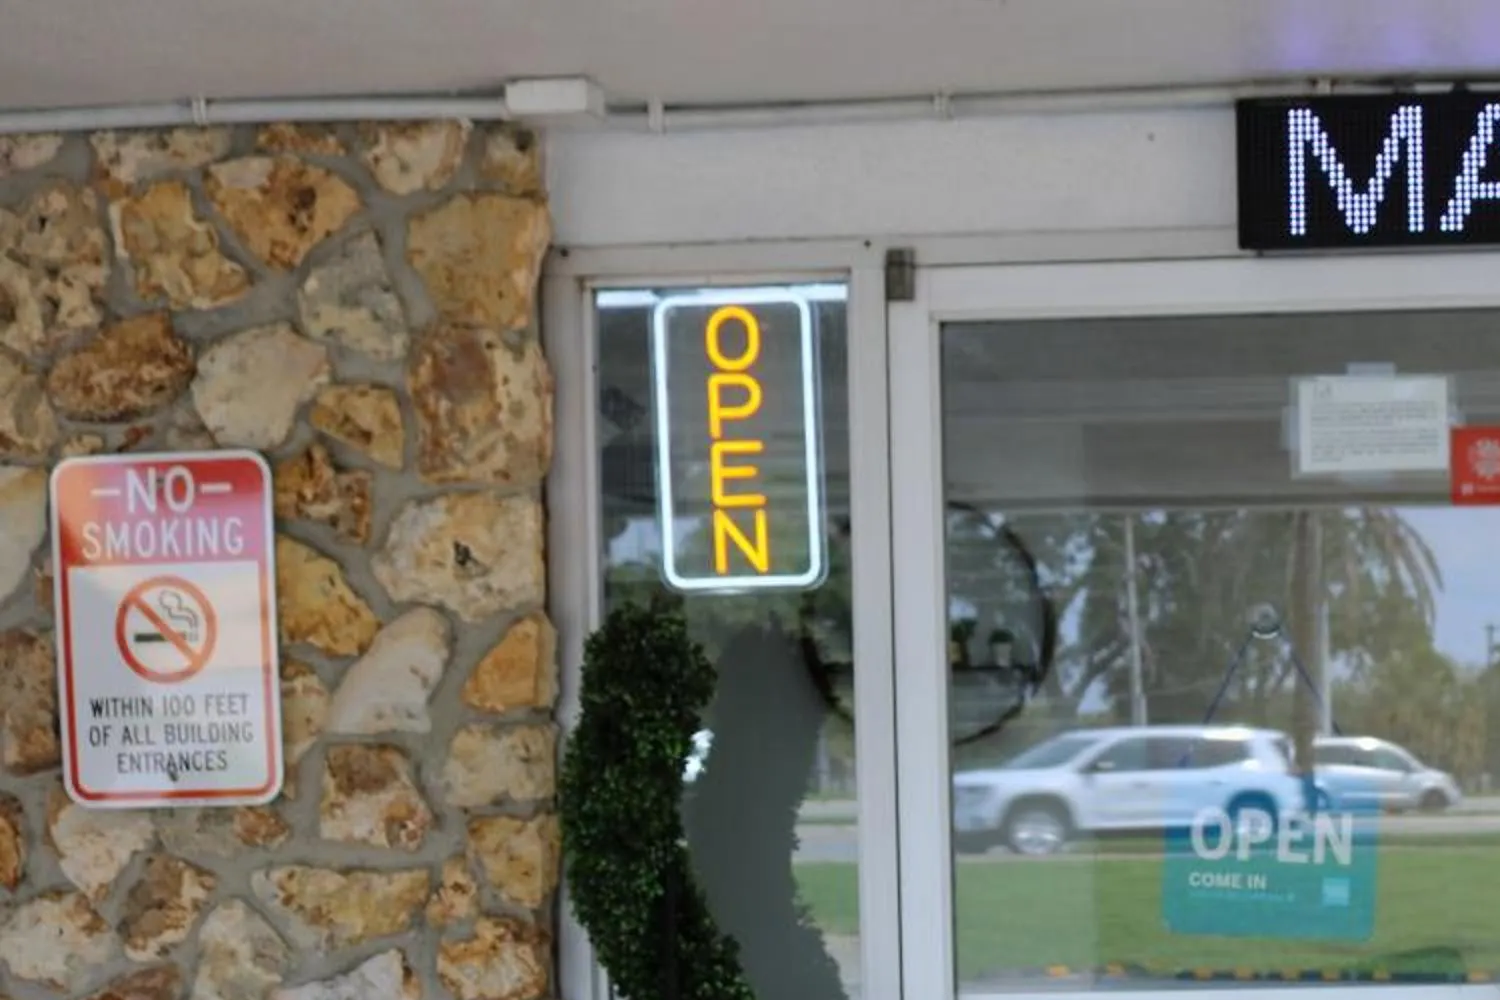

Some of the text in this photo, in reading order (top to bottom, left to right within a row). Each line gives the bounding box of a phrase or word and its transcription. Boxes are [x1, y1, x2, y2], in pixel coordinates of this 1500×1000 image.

[705, 305, 770, 575] OPEN
[126, 465, 195, 514] NO
[81, 517, 245, 560] SMOKING
[89, 693, 250, 720] WITHIN 100 FEET
[88, 720, 254, 746] OF ALL BUILDING
[116, 750, 229, 775] ENTRANCES
[1190, 805, 1354, 866] OPEN
[1188, 871, 1267, 890] COME IN
